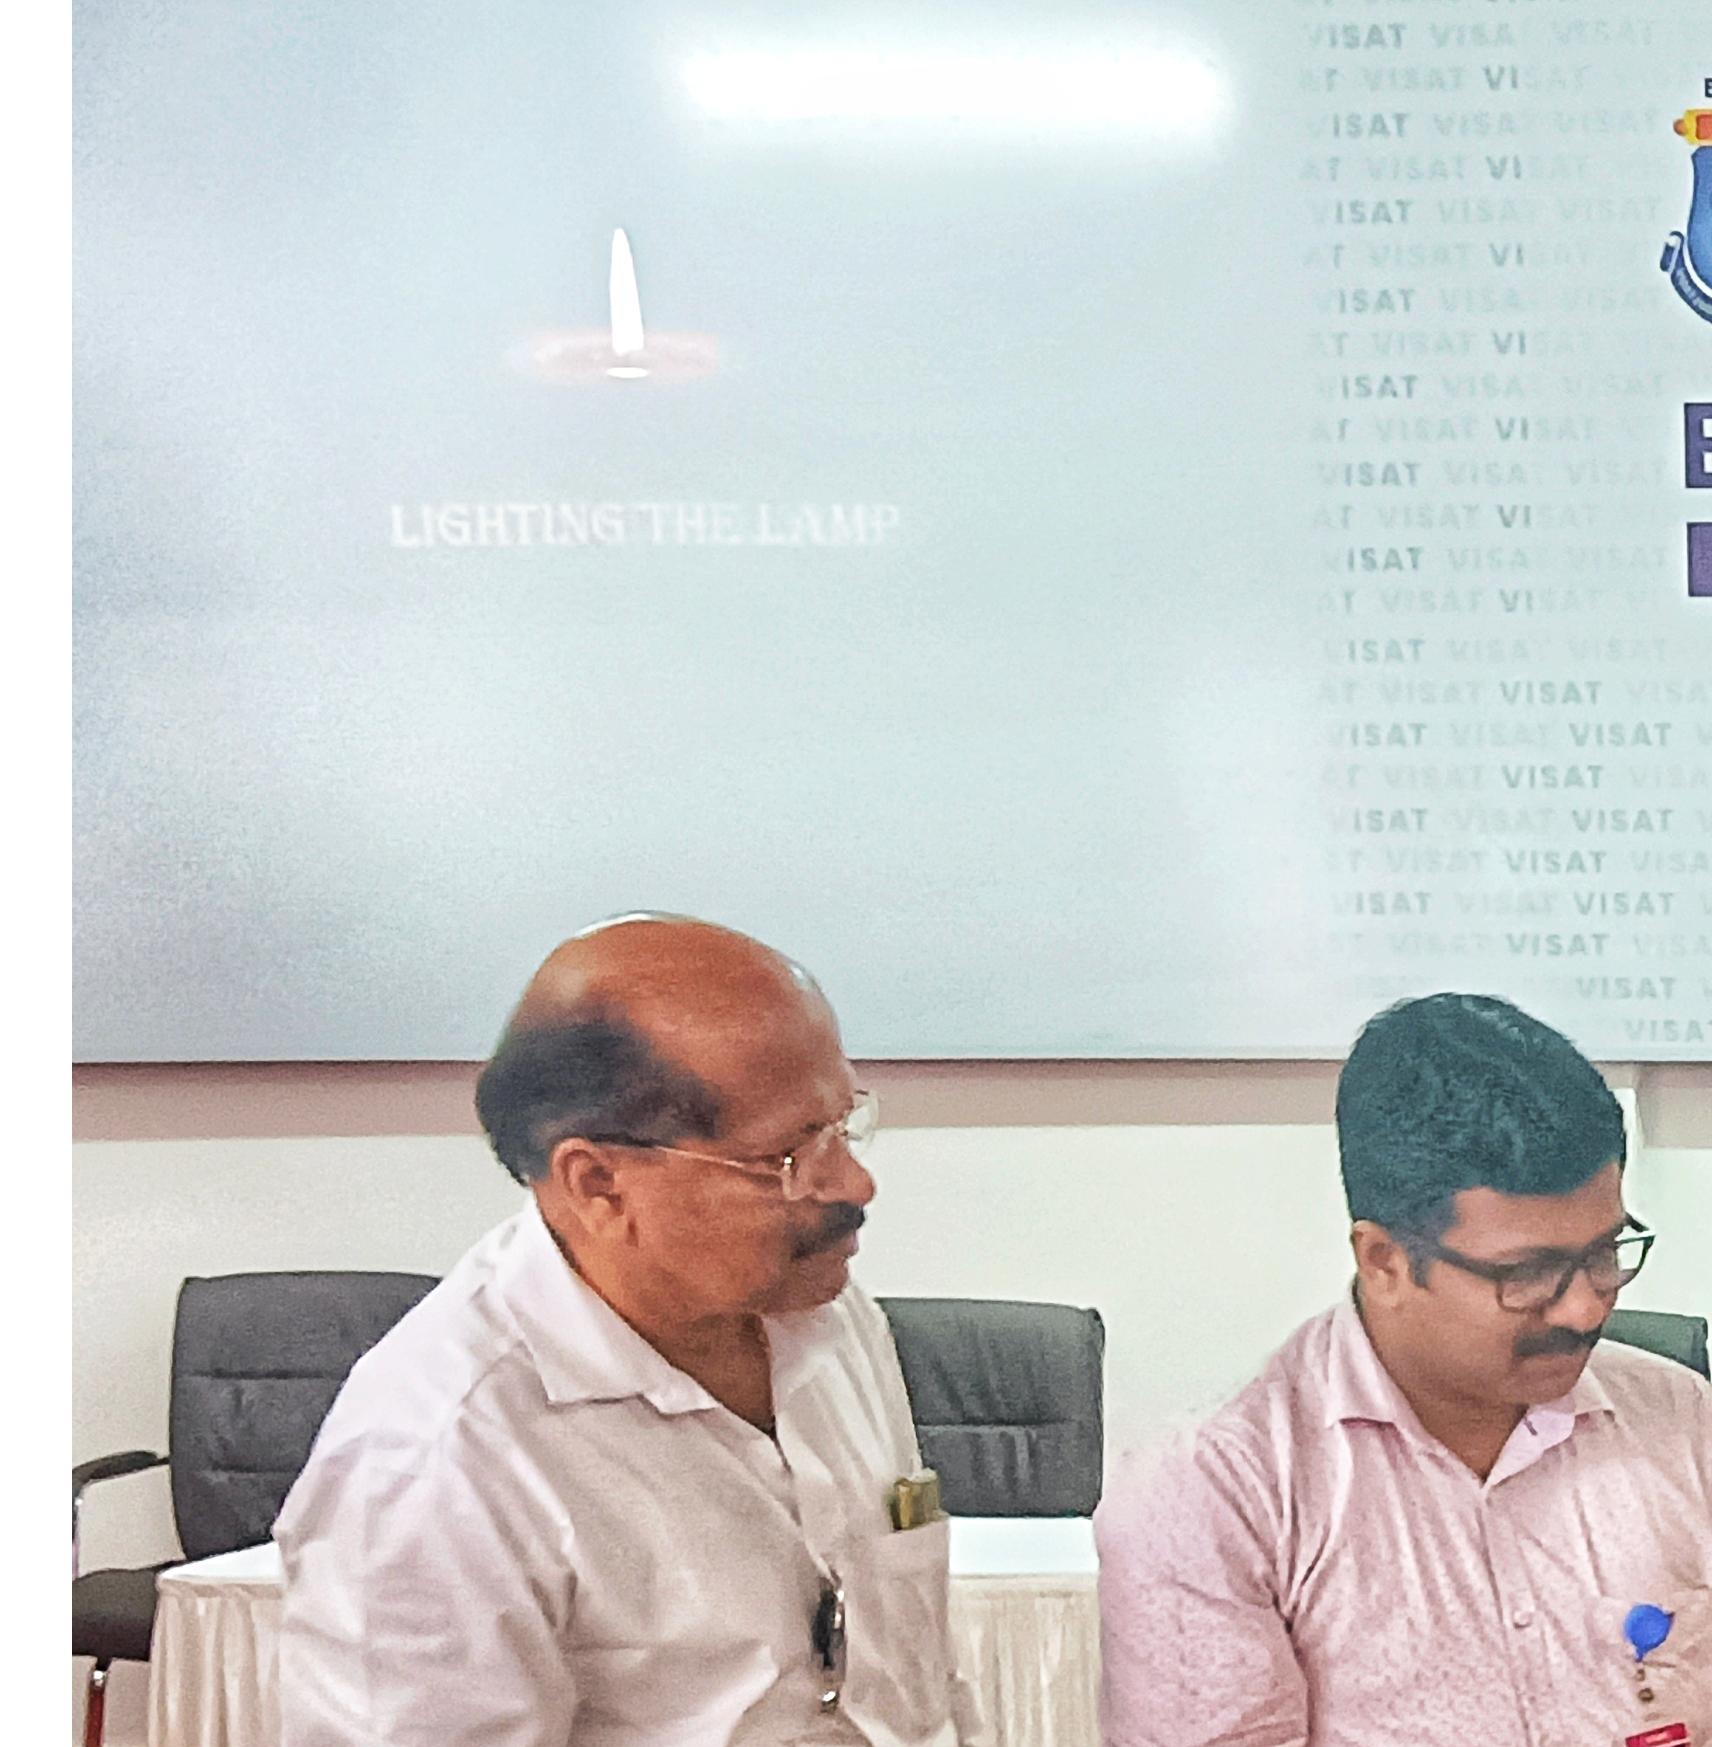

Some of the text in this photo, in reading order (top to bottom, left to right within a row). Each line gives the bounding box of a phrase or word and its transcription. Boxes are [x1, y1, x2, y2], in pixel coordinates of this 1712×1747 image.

[391, 502, 898, 547] LIGHTING THE LAMP
[1501, 680, 1602, 705] VISAT
[1571, 722, 1672, 747] VISAT
[1501, 765, 1605, 790] VISAT
[1570, 808, 1674, 833] VISAT
[1505, 849, 1606, 874] VISAT
[1572, 891, 1676, 916] VISAT
[1507, 932, 1608, 957] VISAT
[1576, 975, 1677, 1000] VISAT
